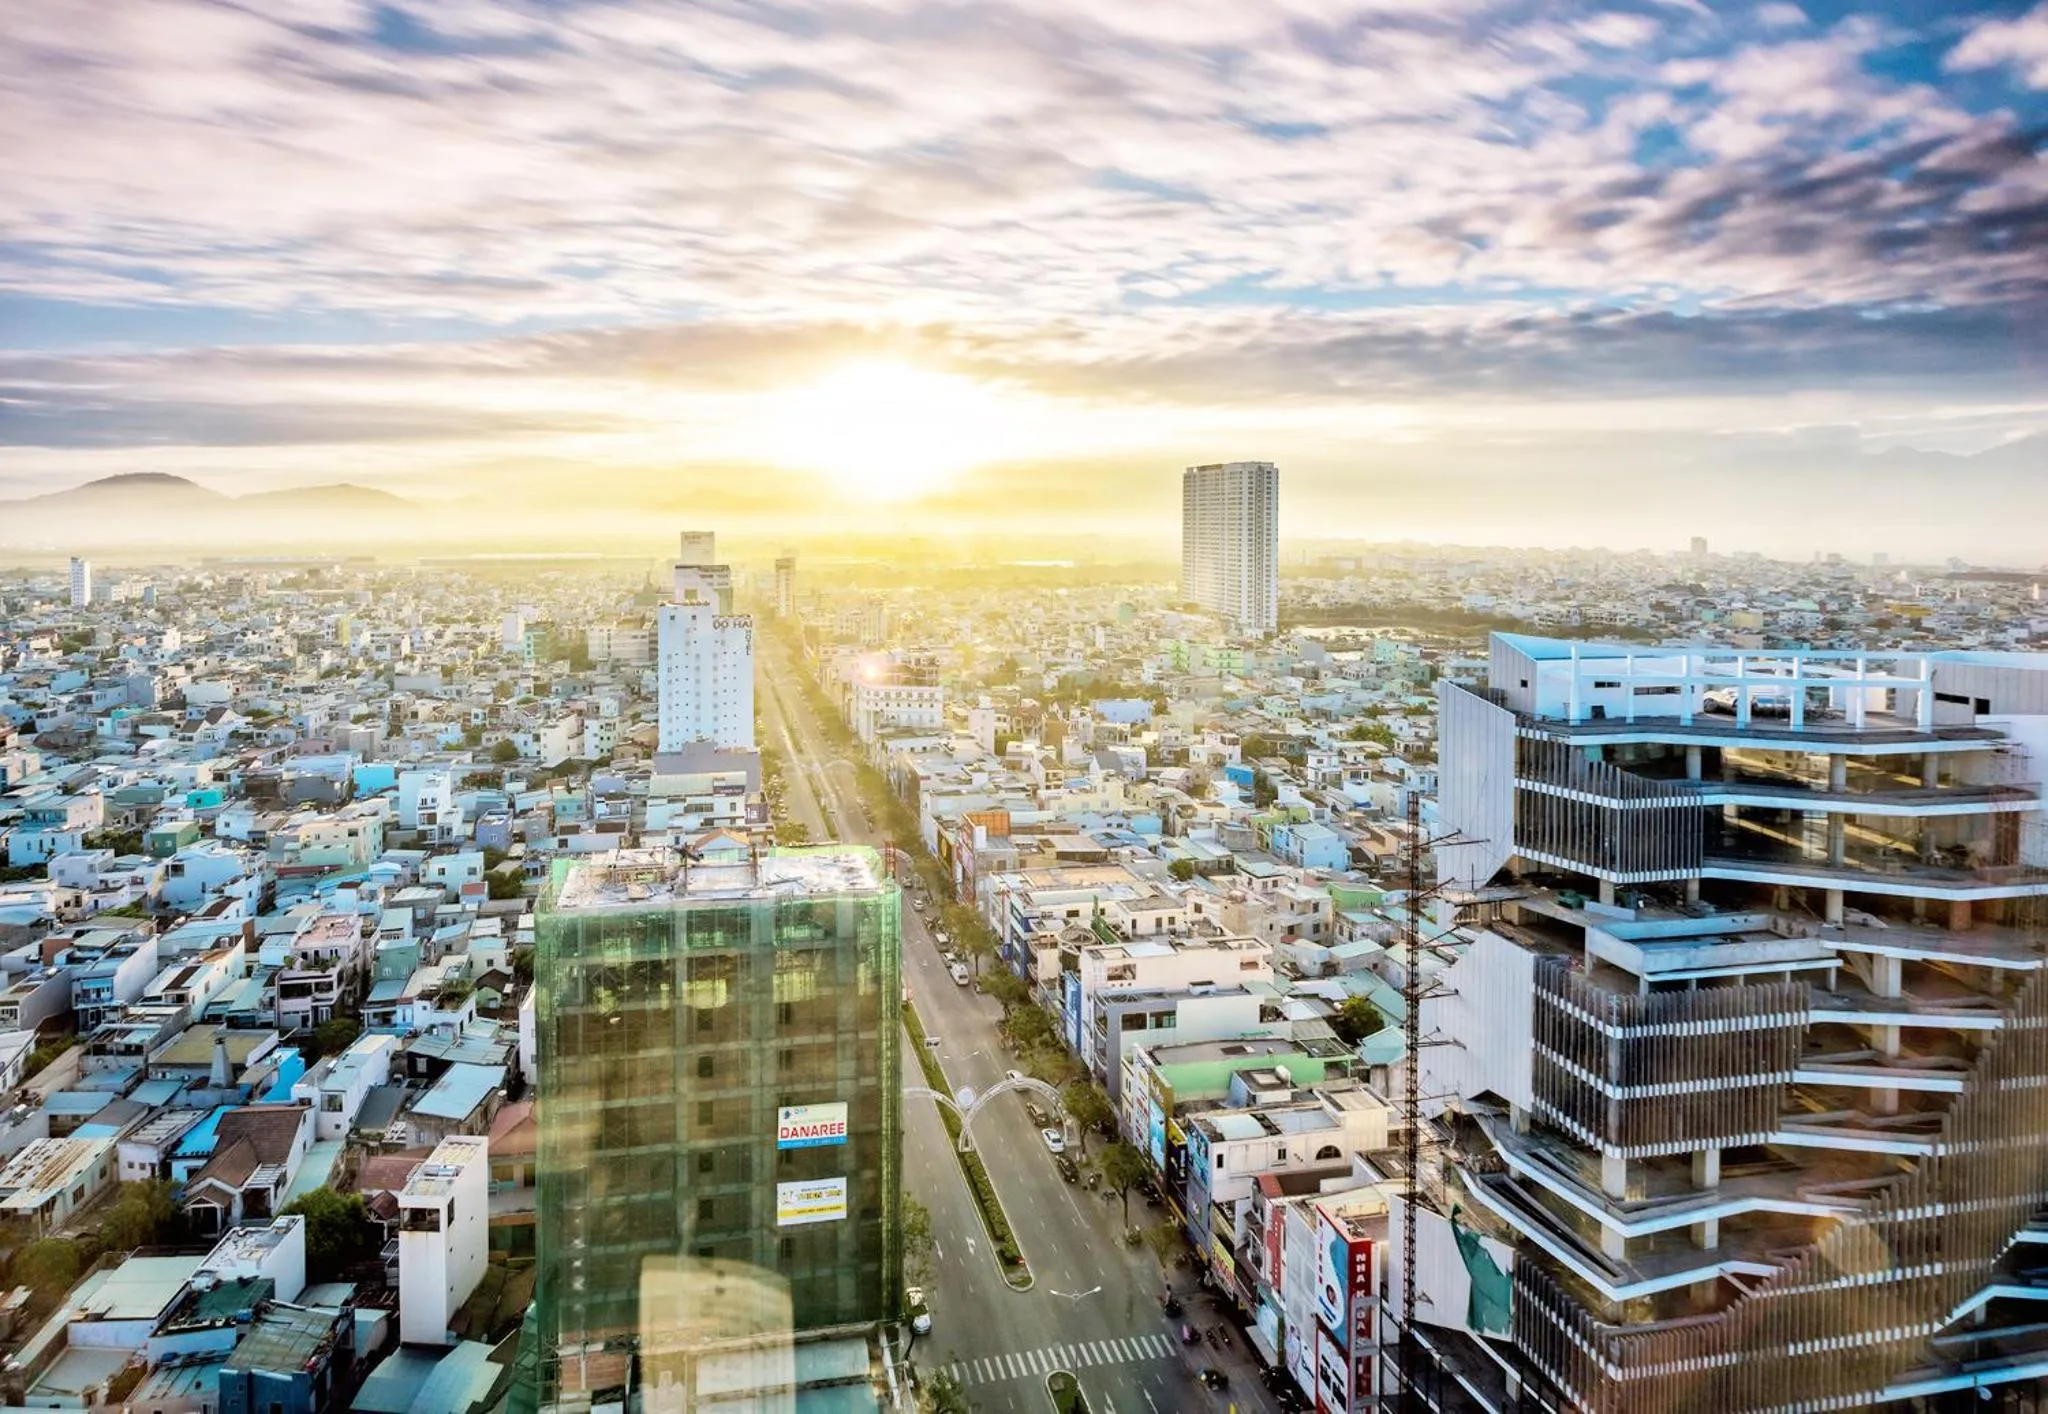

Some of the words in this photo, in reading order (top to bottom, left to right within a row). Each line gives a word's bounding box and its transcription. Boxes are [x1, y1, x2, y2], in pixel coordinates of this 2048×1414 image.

[780, 1122, 845, 1139] DANAREE
[1355, 1253, 1367, 1283] NHA
[1355, 1289, 1366, 1330] KOA
